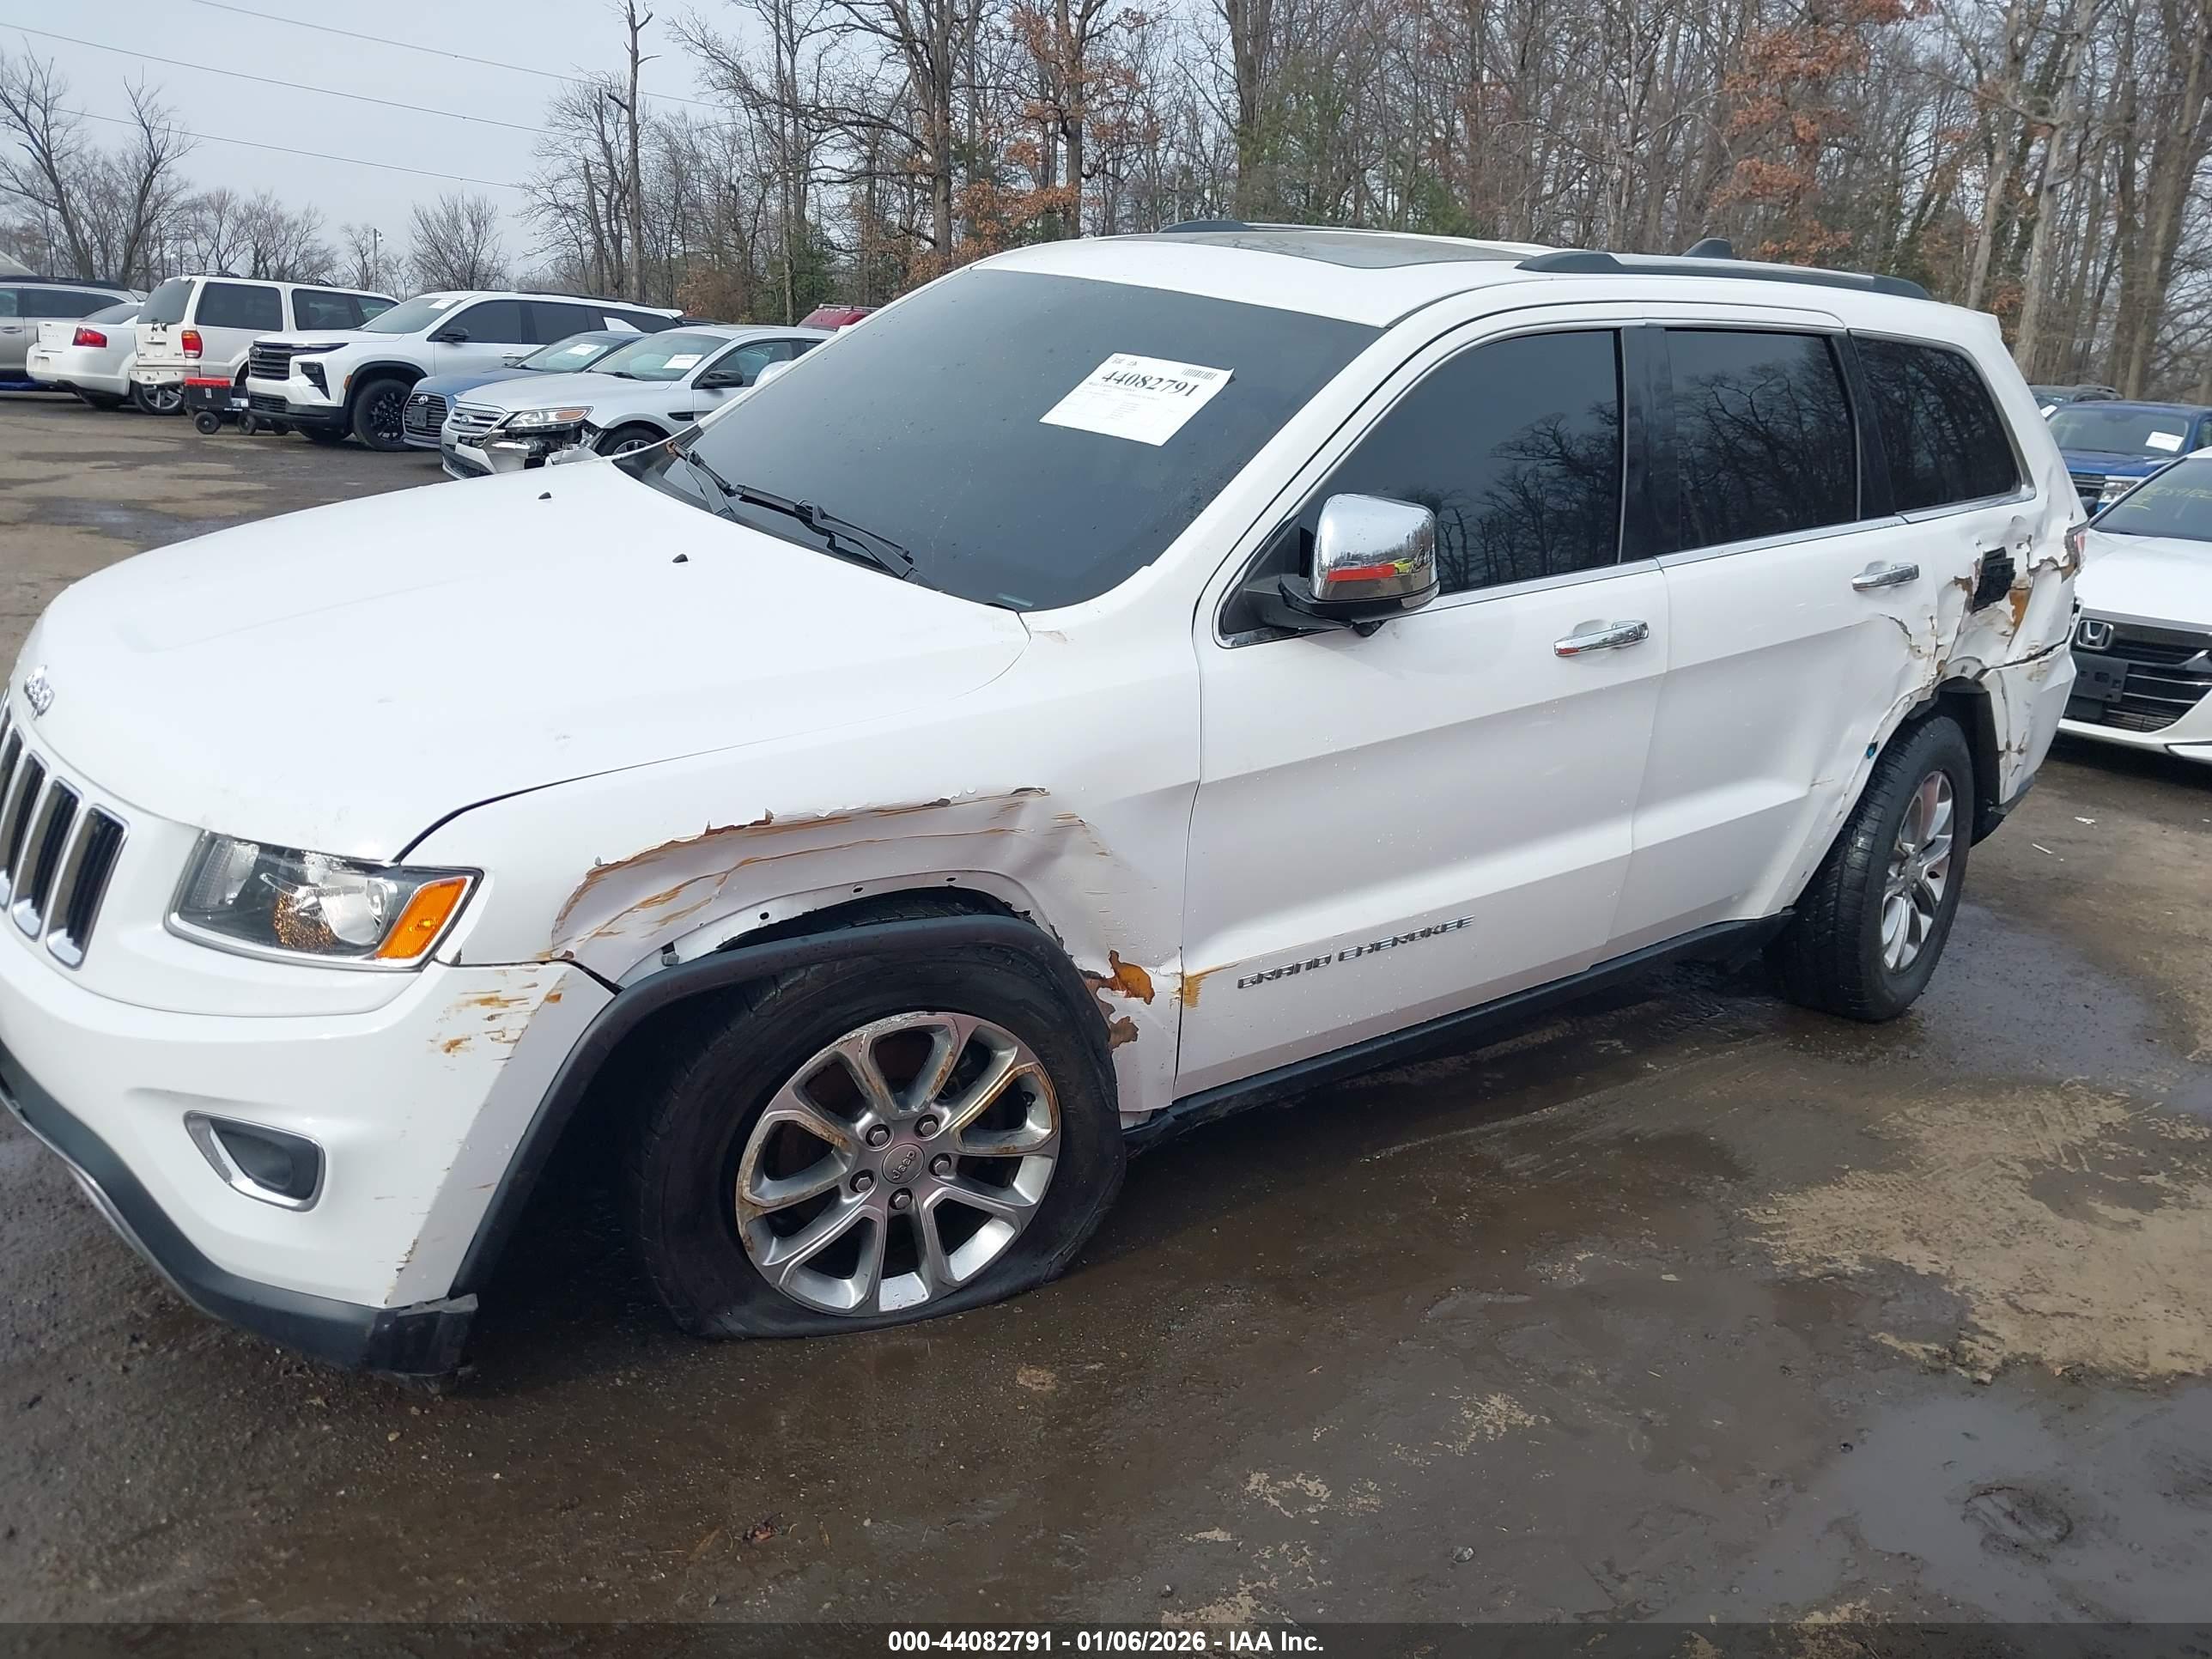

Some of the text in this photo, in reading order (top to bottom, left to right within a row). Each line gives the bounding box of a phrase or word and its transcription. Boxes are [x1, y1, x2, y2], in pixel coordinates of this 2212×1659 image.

[1102, 370, 1200, 397] 44082791
[1237, 914, 1475, 989] GRAND CHEROKEE
[893, 1151, 916, 1180] Jeep
